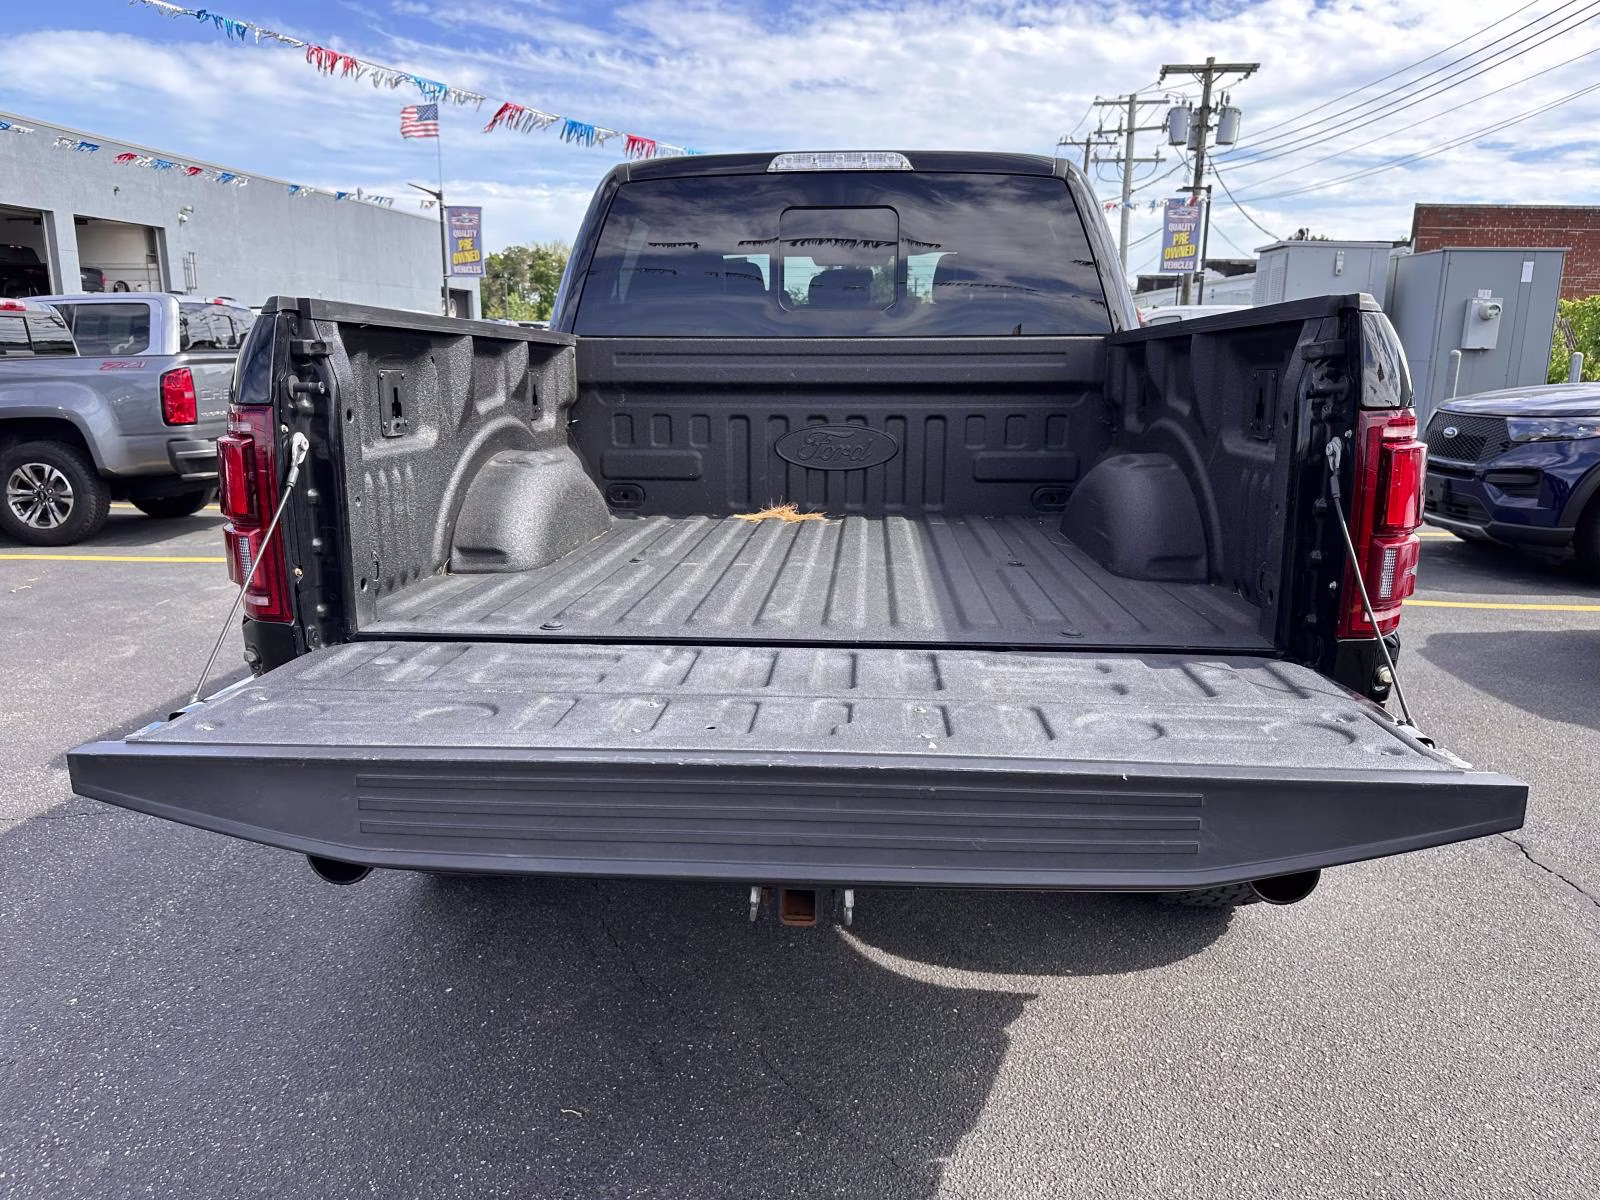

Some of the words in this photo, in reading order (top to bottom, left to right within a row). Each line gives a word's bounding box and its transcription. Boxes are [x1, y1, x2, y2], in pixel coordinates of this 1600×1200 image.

[452, 229, 478, 238] QUALITY
[1168, 223, 1196, 232] QUALITY
[457, 237, 474, 251] PRE
[1173, 231, 1191, 246] PRE
[452, 249, 481, 266] OWNED
[1164, 244, 1196, 260] OWNED
[1163, 261, 1194, 270] VEHICLES
[797, 429, 873, 461] Ford
